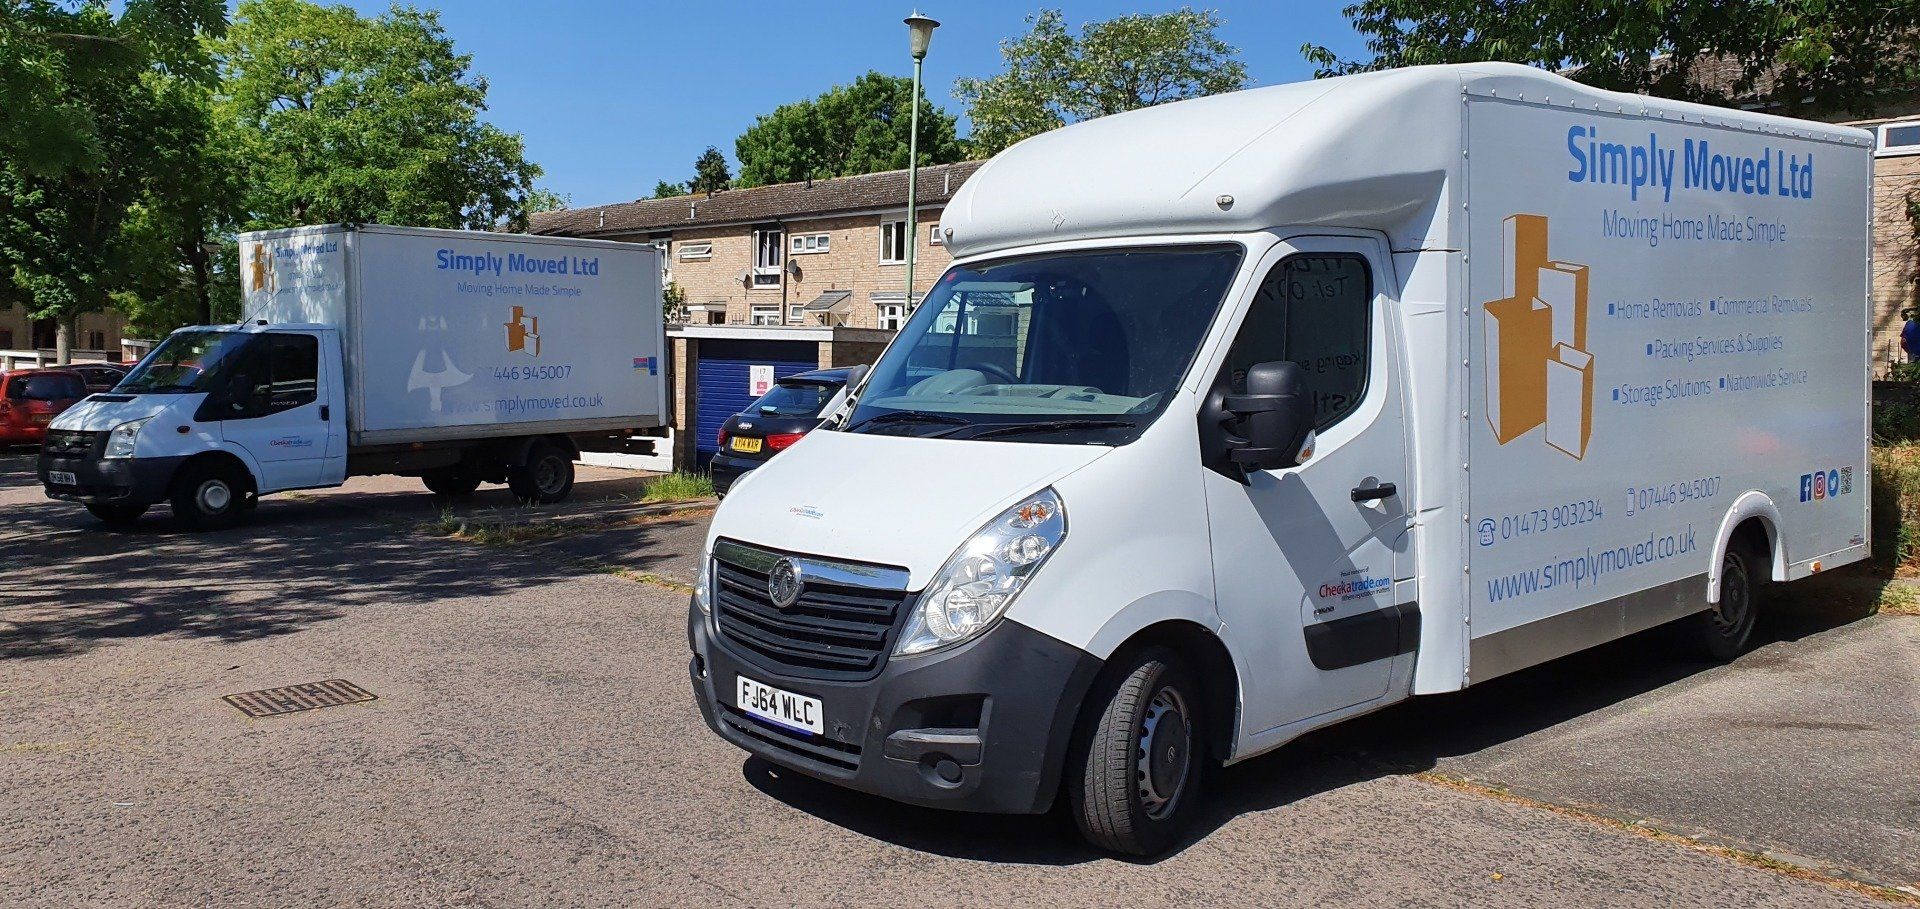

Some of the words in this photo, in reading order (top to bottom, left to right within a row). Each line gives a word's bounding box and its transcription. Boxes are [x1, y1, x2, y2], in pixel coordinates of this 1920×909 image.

[1567, 125, 1675, 203] Simply
[1684, 138, 1770, 196] Moved
[1778, 150, 1813, 199] Ltd
[1603, 209, 1658, 247] Moving
[1662, 213, 1703, 240] Home
[1708, 214, 1743, 242] Made
[1746, 216, 1786, 248] Simple
[326, 242, 337, 253] Ltd
[436, 249, 502, 276] Simply
[508, 253, 567, 275] Moved
[574, 257, 599, 276] Ltd
[457, 282, 493, 296] Moving
[495, 283, 523, 295] Home
[525, 284, 550, 296] Made
[552, 285, 582, 298] Simple
[1617, 301, 1649, 320] Home
[1652, 298, 1702, 318] Removals
[1717, 296, 1768, 316] Commercial
[1772, 295, 1813, 313] Removals
[1655, 338, 1694, 362] Packing
[1696, 336, 1735, 356] Services
[1737, 334, 1744, 352] &
[1746, 333, 1783, 356] Supplies
[523, 365, 572, 380] 945007
[1726, 370, 1778, 392] Nationwide
[1779, 368, 1808, 386] Service
[1621, 383, 1663, 406] Storage
[1665, 378, 1711, 399] Solutions
[1639, 484, 1676, 510] 07446
[1678, 475, 1721, 503] 945007
[1501, 509, 1548, 540] 01473
[1552, 499, 1603, 530] 903234
[1488, 523, 1696, 603] www.simplymoved.co.uk
[1319, 576, 1390, 598] Checkatrade.com
[742, 681, 778, 715] FJ64
[782, 694, 814, 725] WLC
